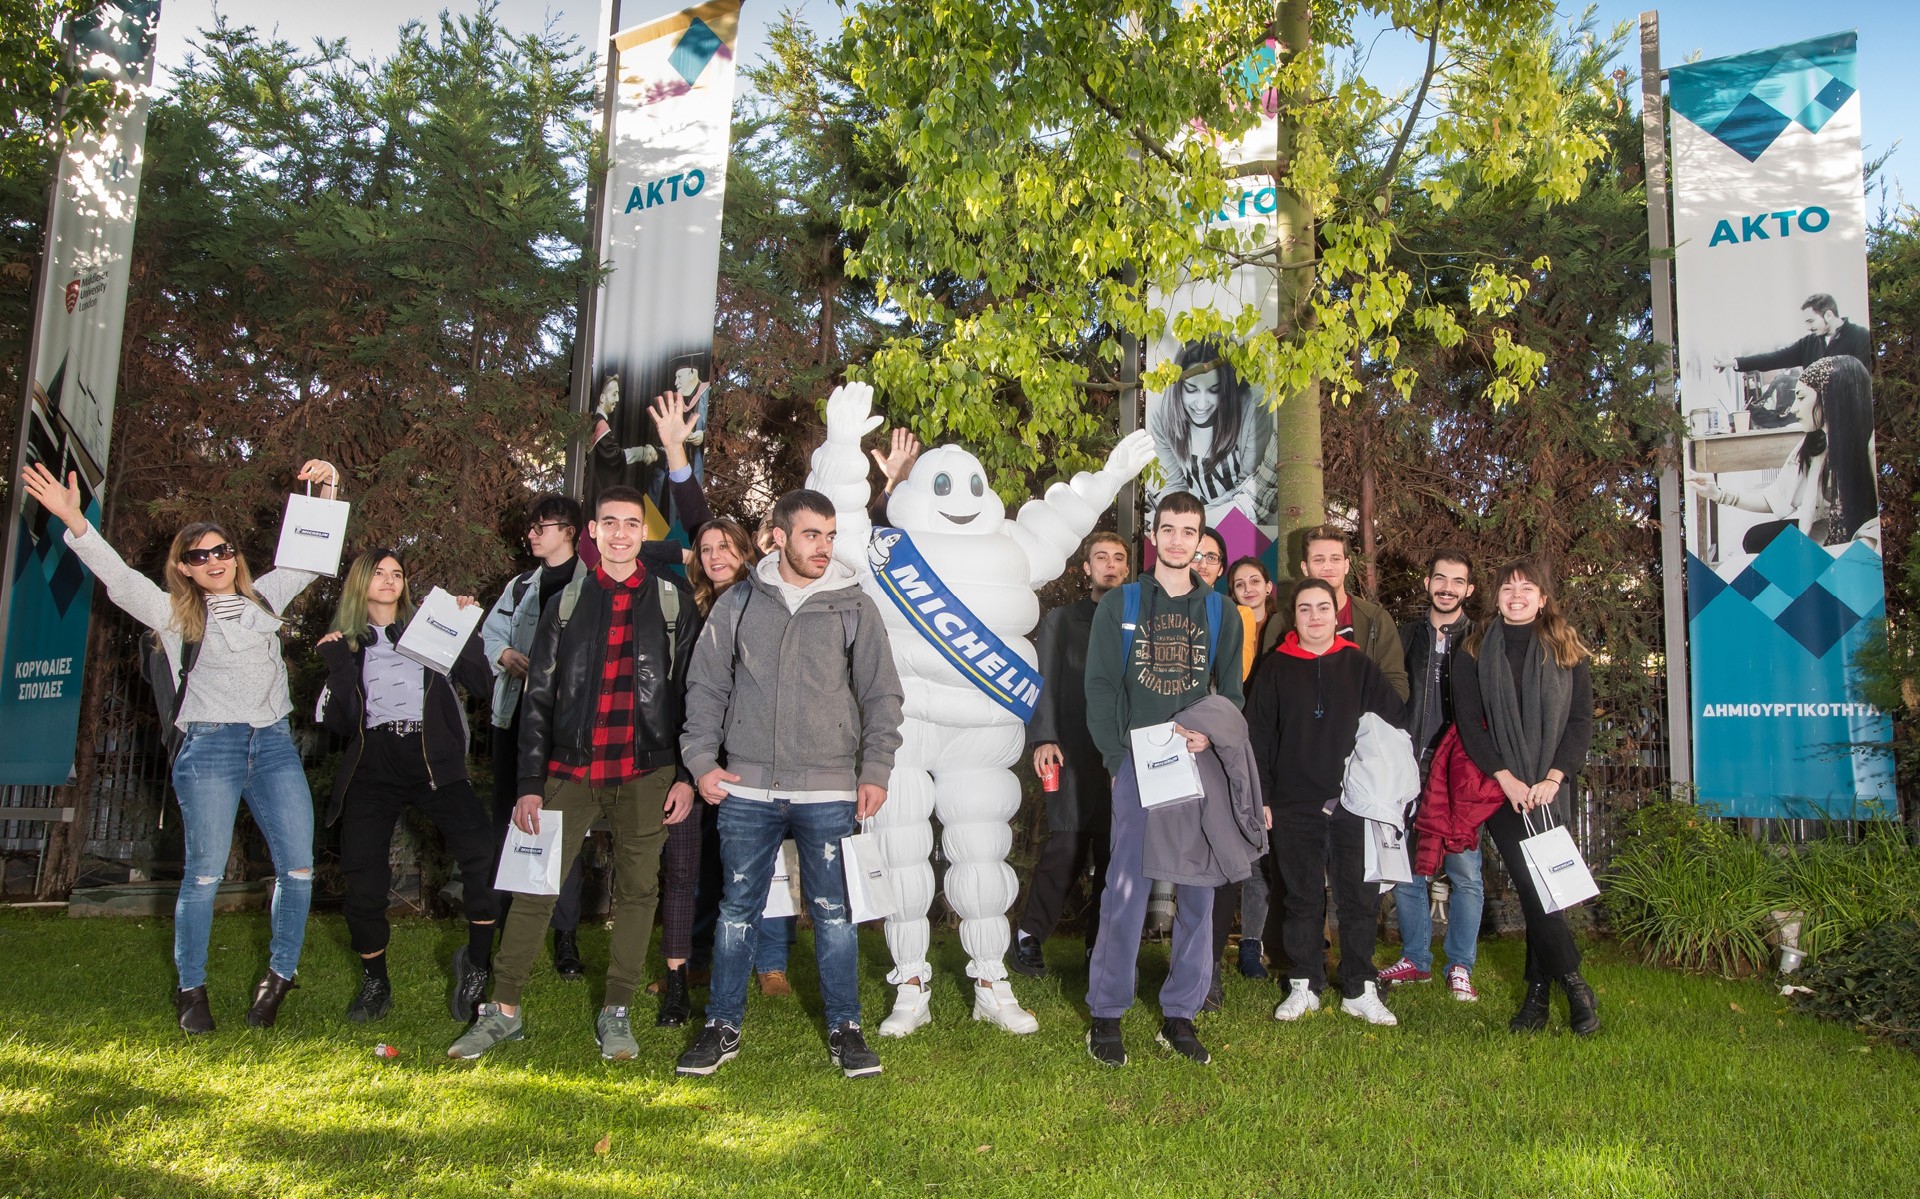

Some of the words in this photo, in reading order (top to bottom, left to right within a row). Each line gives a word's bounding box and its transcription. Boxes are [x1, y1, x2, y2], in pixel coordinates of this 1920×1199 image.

[624, 168, 705, 214] AKTO
[1708, 206, 1830, 247] AKTO
[80, 282, 107, 299] University
[79, 297, 98, 312] London
[890, 564, 1040, 708] MICHELIN
[15, 657, 72, 679] ΚΟΡΥΦΑΙΕΣ
[18, 680, 63, 700] ΣΠΟΥΔΕΣ
[1702, 703, 1880, 717] ΔΗΜΙΟΥΡΓΙΚΟΤΗΤΑ
